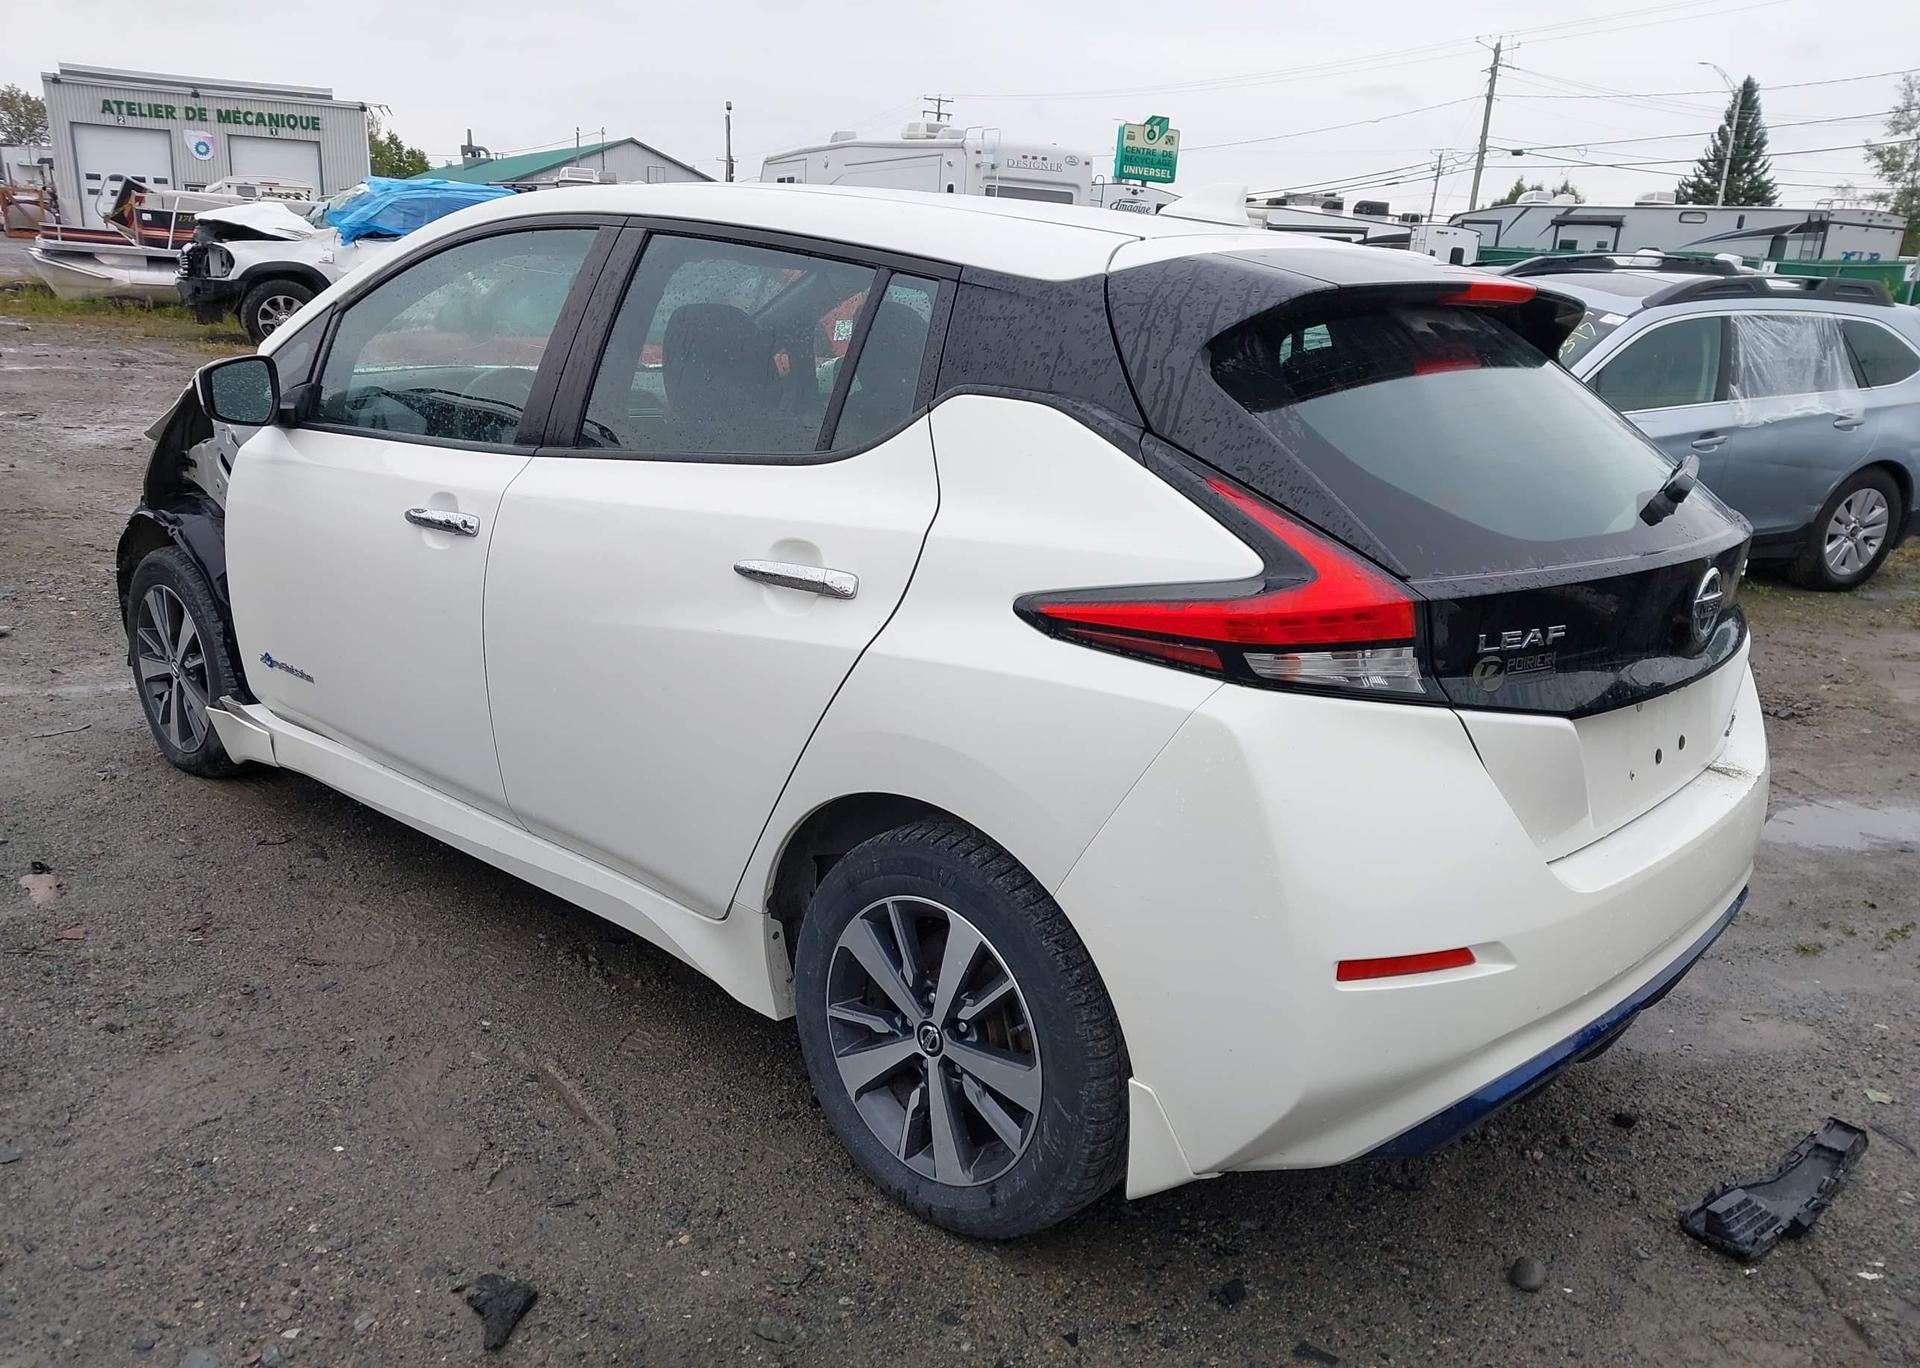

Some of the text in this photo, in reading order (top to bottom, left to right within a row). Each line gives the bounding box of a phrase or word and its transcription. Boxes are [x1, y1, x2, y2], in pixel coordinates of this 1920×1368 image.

[101, 98, 177, 120] ATELIER
[184, 105, 208, 122] DE
[1125, 145, 1174, 159] CENTRE DE
[1007, 158, 1063, 173] DESIGNER
[1123, 164, 1172, 179] UNIVERSEL
[1477, 624, 1567, 654] LEAF
